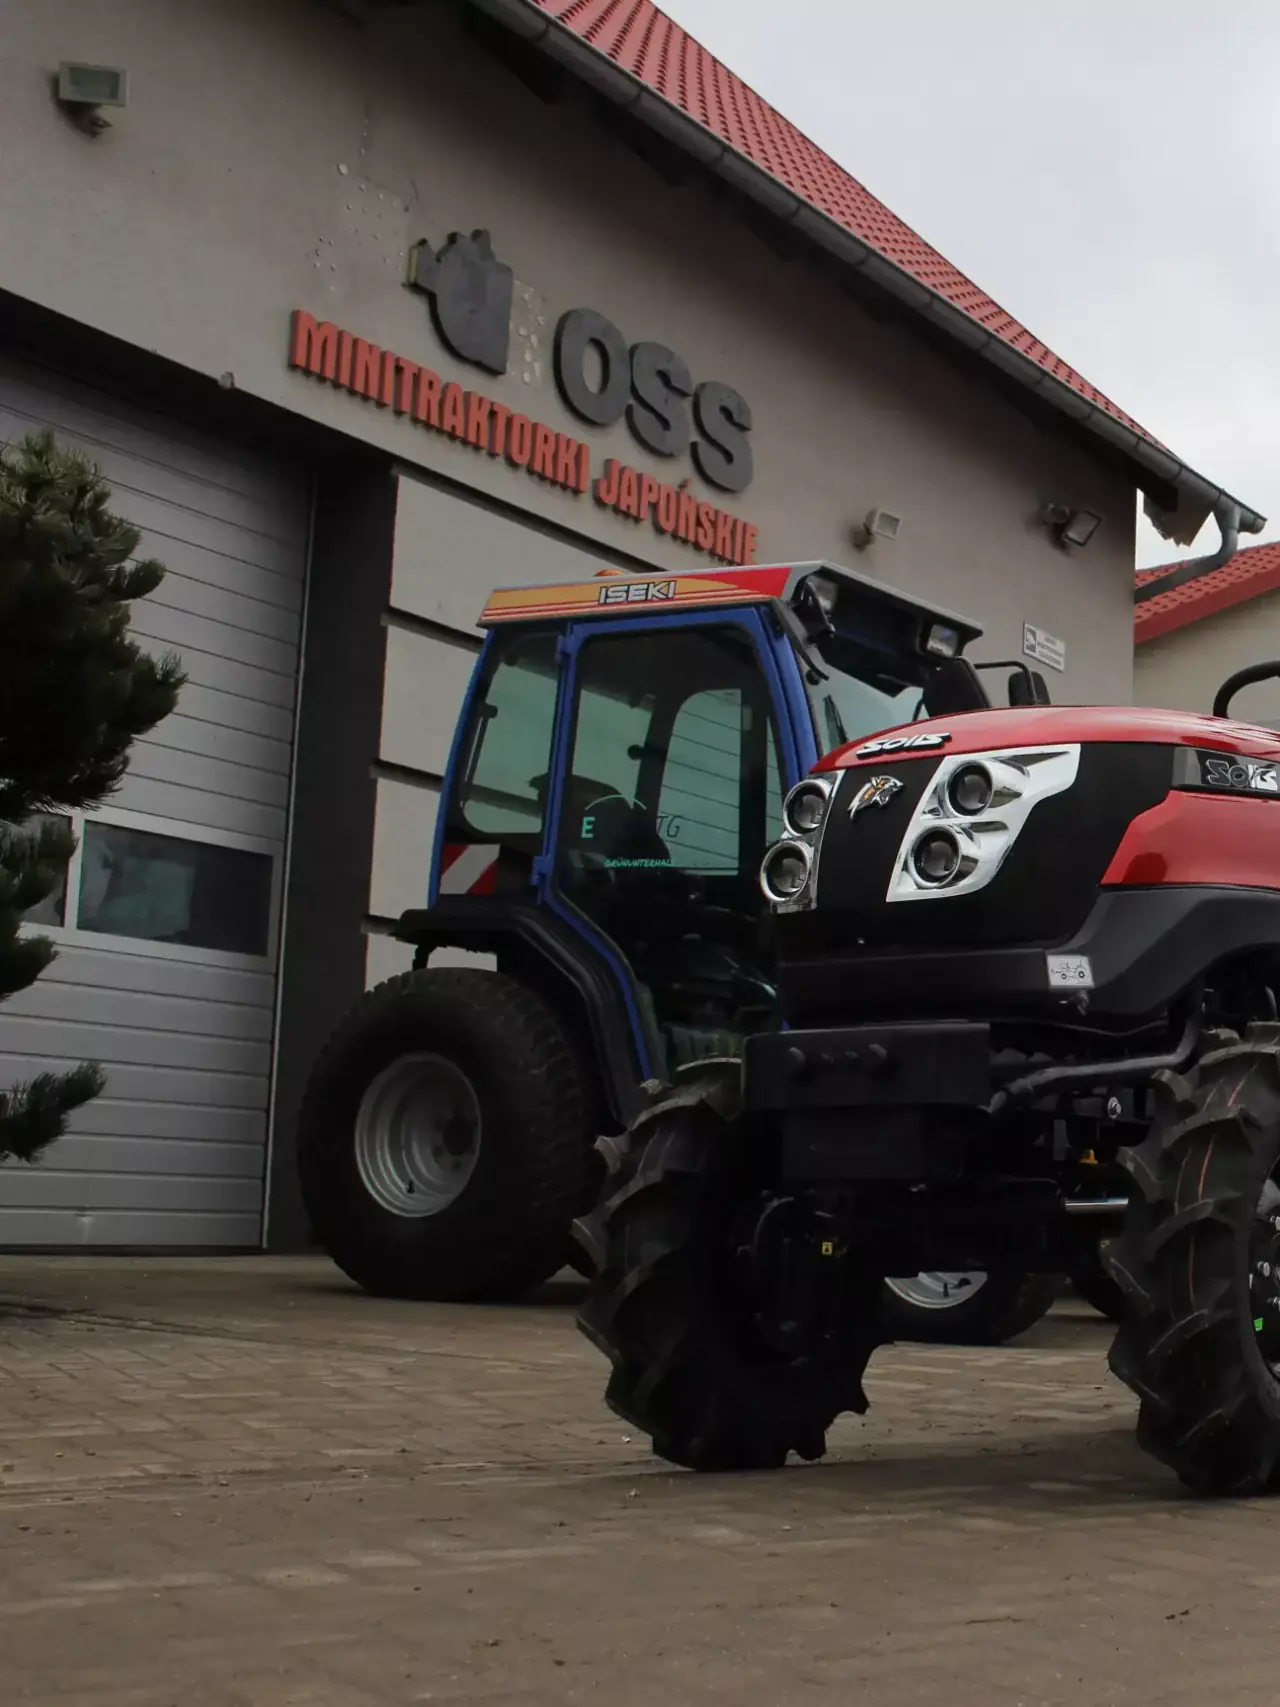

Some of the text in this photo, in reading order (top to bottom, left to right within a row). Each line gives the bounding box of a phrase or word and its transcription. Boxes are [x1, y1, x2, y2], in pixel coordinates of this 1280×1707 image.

[288, 310, 759, 565] MINITRAKTORKI JAPOŃSKIE
[554, 308, 753, 492] OSS
[599, 580, 677, 604] ISEKI
